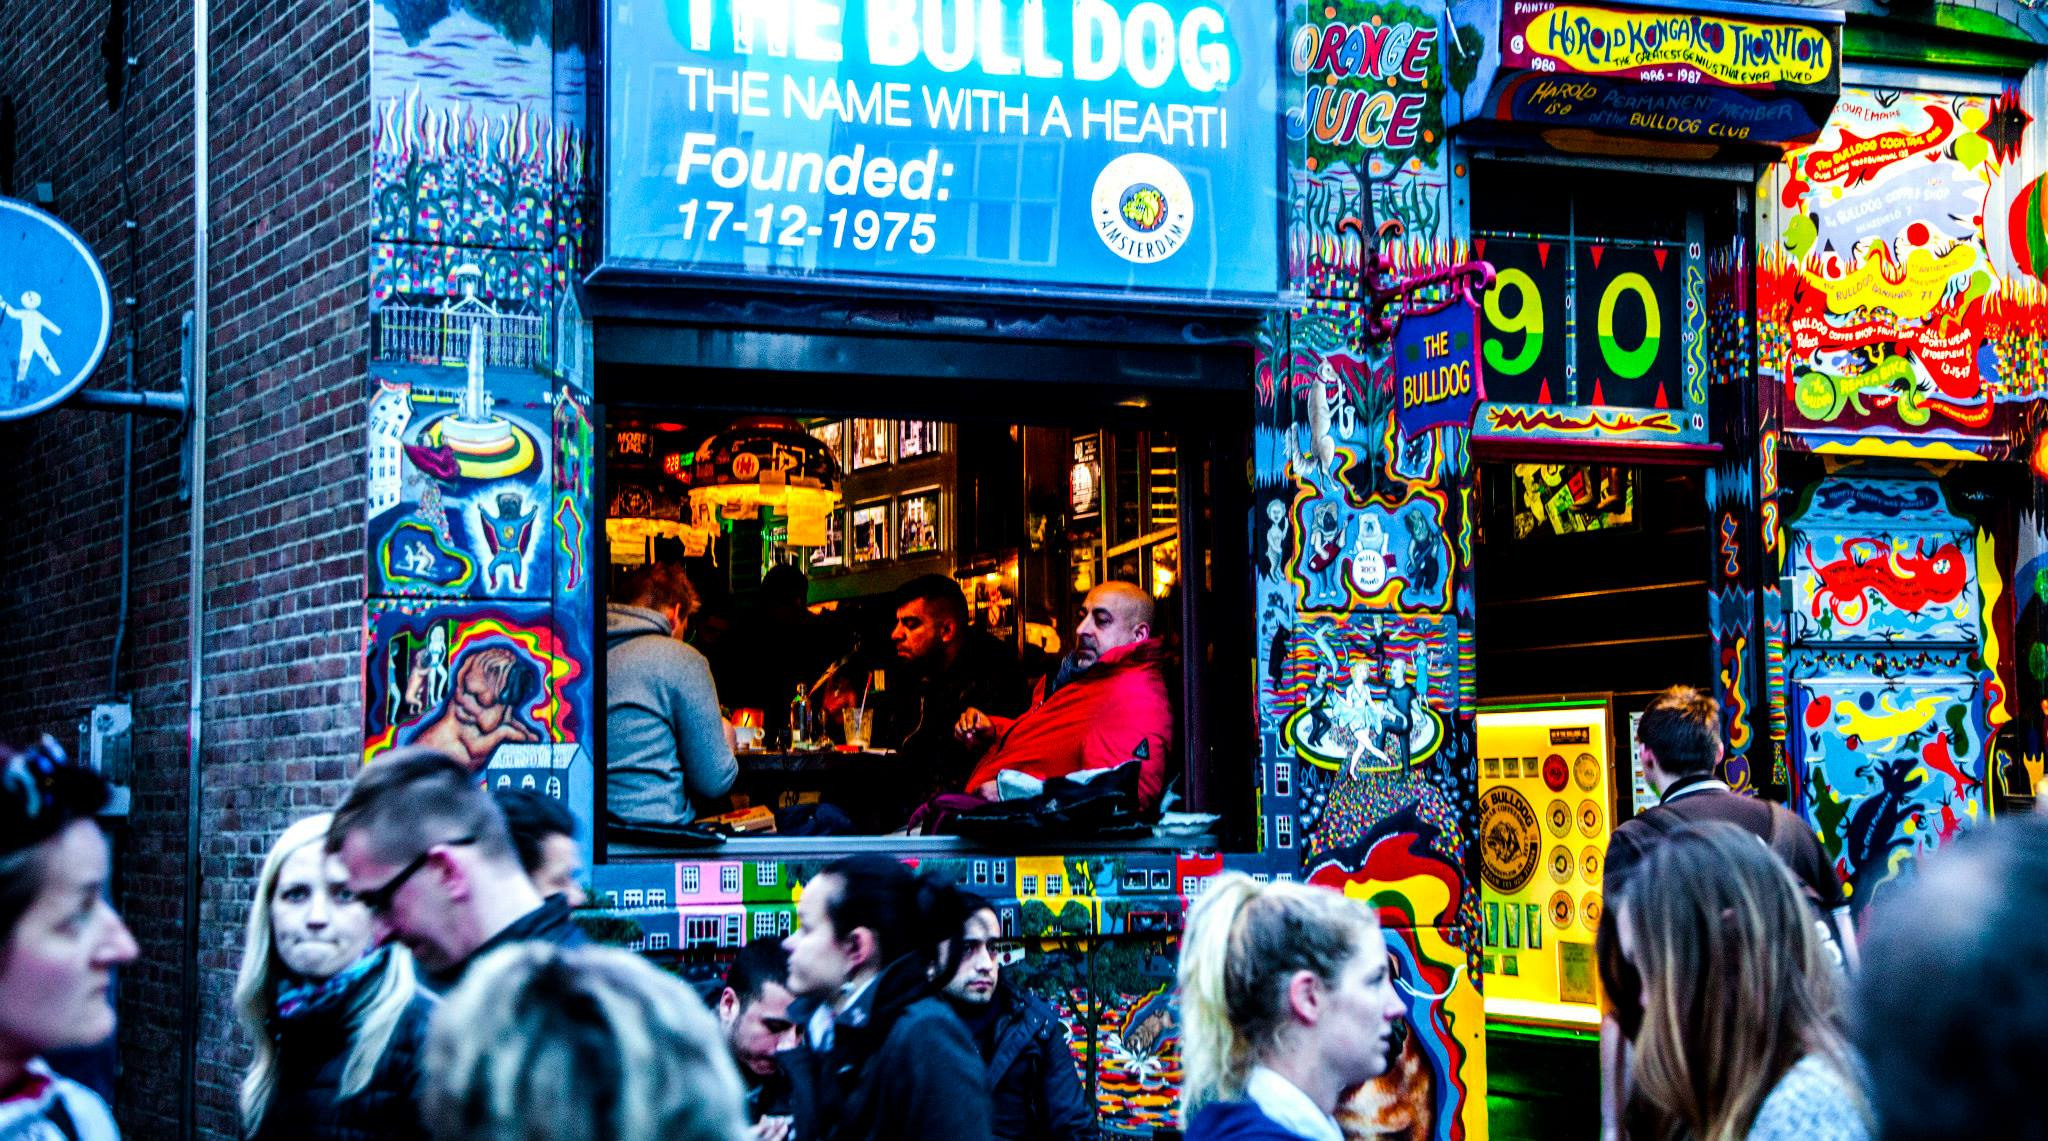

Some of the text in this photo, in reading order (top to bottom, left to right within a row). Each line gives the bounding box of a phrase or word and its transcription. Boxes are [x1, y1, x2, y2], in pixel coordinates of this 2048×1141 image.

[863, 0, 1231, 93] BULLDOG
[1291, 22, 1438, 81] ORANGE
[1531, 57, 1556, 72] 1980
[1527, 81, 1597, 105] HAROLD
[1640, 68, 1665, 82] 1986
[1677, 68, 1702, 84] 1987
[1780, 69, 1812, 81] LIVED
[678, 66, 770, 117] THE
[783, 74, 911, 127] NAME
[922, 85, 1029, 135] WITH
[1040, 95, 1072, 138] A
[1286, 85, 1427, 149] JUICE
[1630, 112, 1702, 134] BULLDOG
[1708, 122, 1750, 139] CLUB
[676, 132, 954, 201] Founded:
[1832, 139, 1877, 164] BULLDOG
[678, 198, 938, 254] 17-12-1975
[1100, 219, 1185, 259] AMSTERDAM
[1792, 317, 1828, 336] BULLDOG
[1423, 331, 1449, 360] THE
[1403, 360, 1470, 409] BULLDOG
[1490, 791, 1533, 828] BULLDOG
